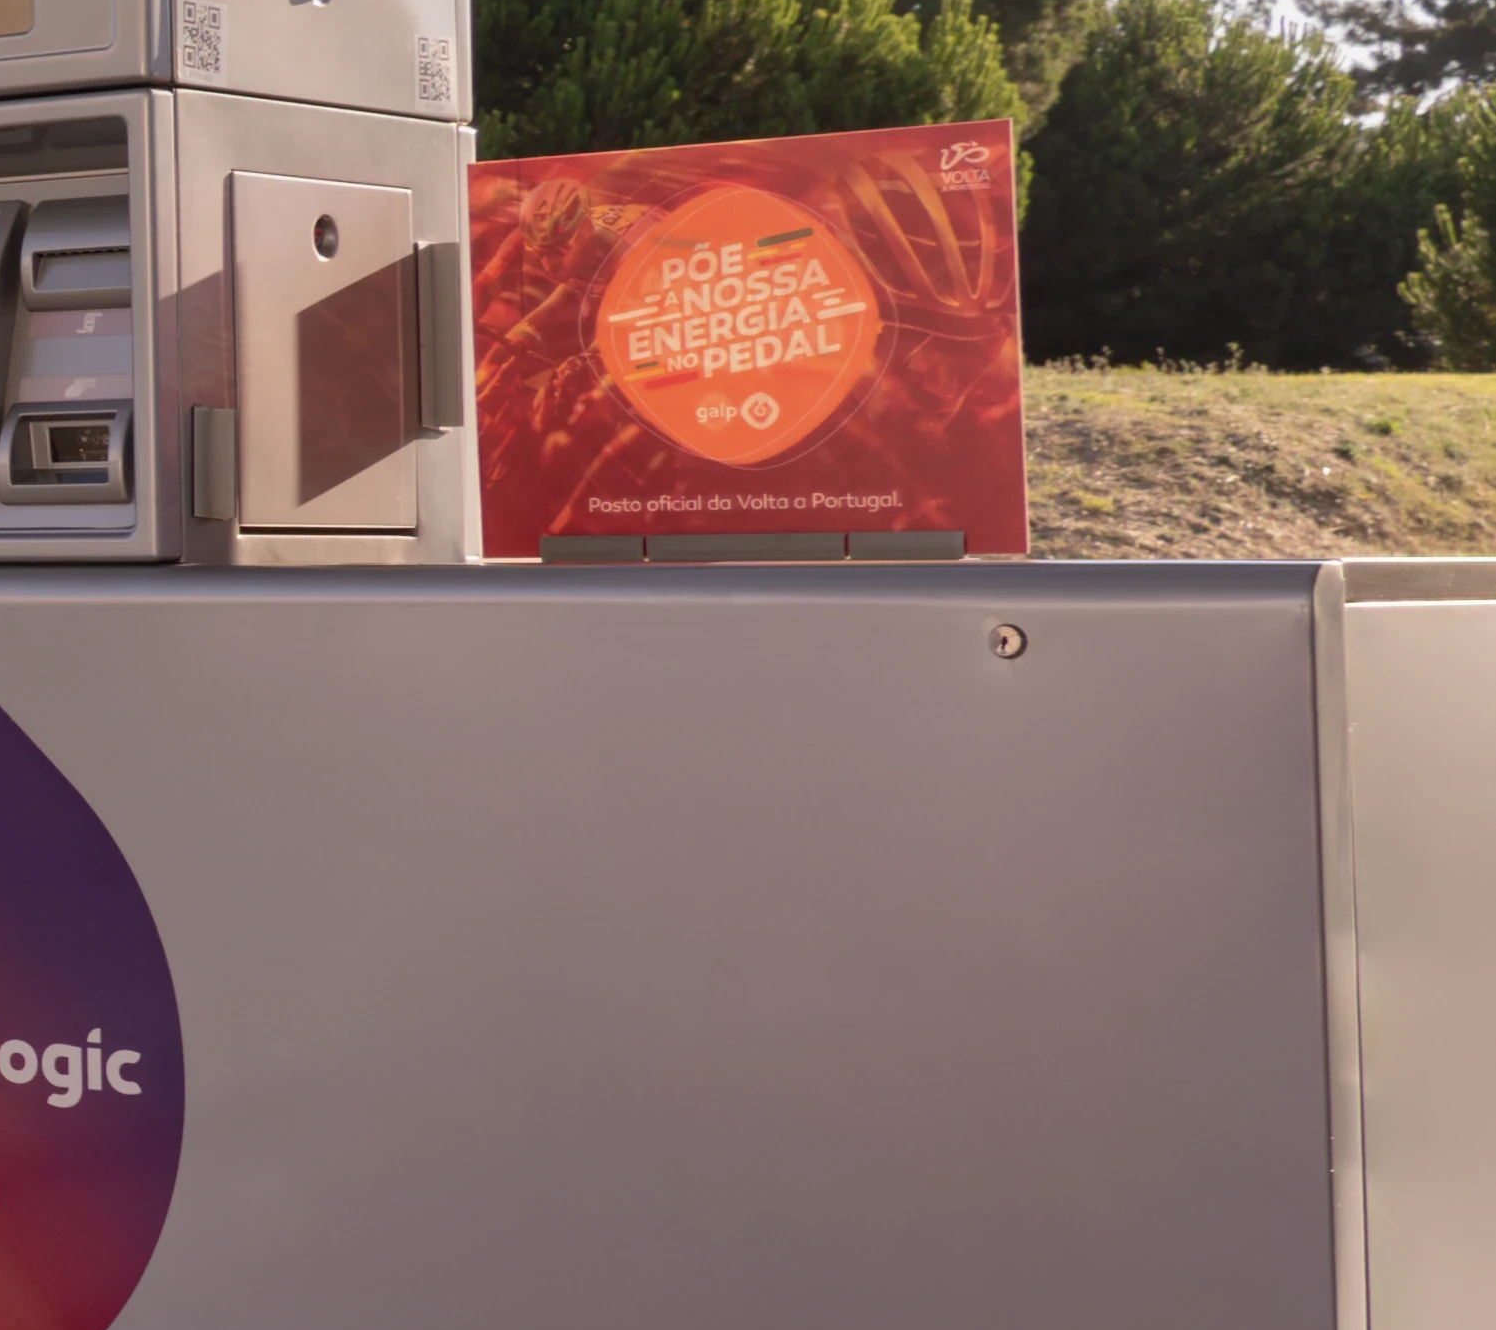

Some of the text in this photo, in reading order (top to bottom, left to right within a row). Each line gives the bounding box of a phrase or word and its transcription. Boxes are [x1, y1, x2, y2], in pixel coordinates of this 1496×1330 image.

[941, 169, 990, 184] VOLTA
[662, 242, 743, 289] PÕE
[664, 258, 830, 316] A NOSSA
[628, 296, 811, 361] ENERGIA
[667, 325, 841, 378] NO PEDAL
[696, 405, 737, 424] galp
[588, 491, 903, 513] Posto oficial da Volta a Portugal.
